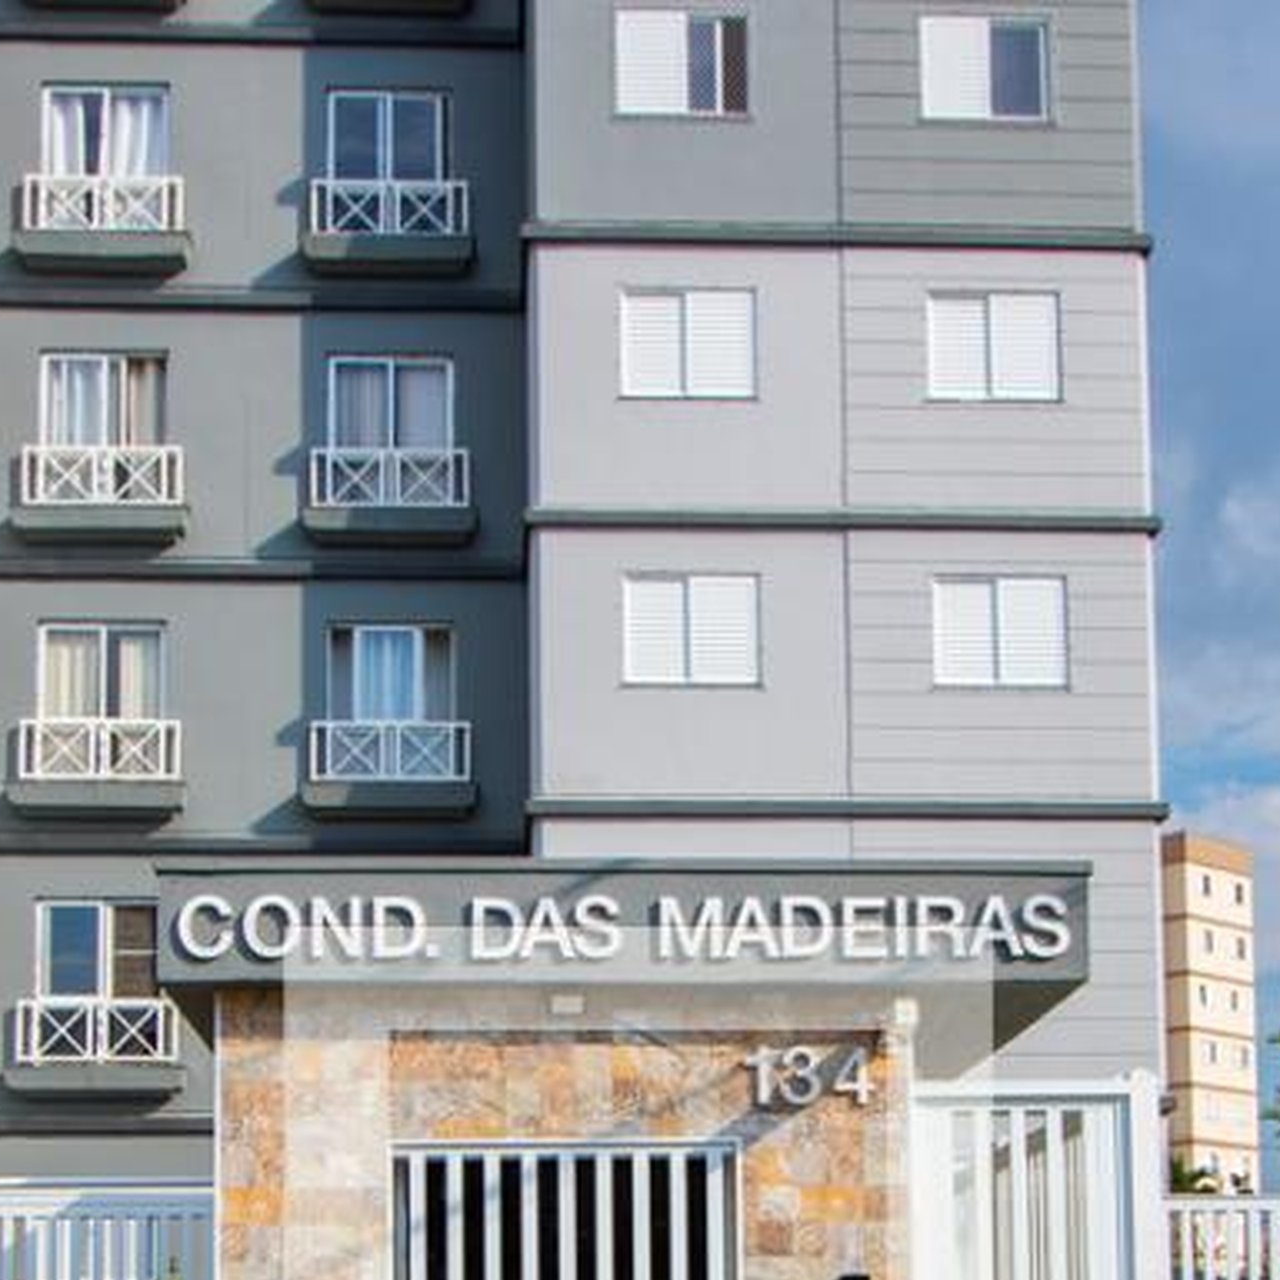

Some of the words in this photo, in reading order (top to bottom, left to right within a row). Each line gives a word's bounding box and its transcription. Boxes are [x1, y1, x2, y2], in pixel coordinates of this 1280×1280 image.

[175, 894, 441, 960] COND.
[469, 895, 621, 960] DAS
[657, 894, 1072, 960] MADEIRAS
[744, 1044, 876, 1105] 134
